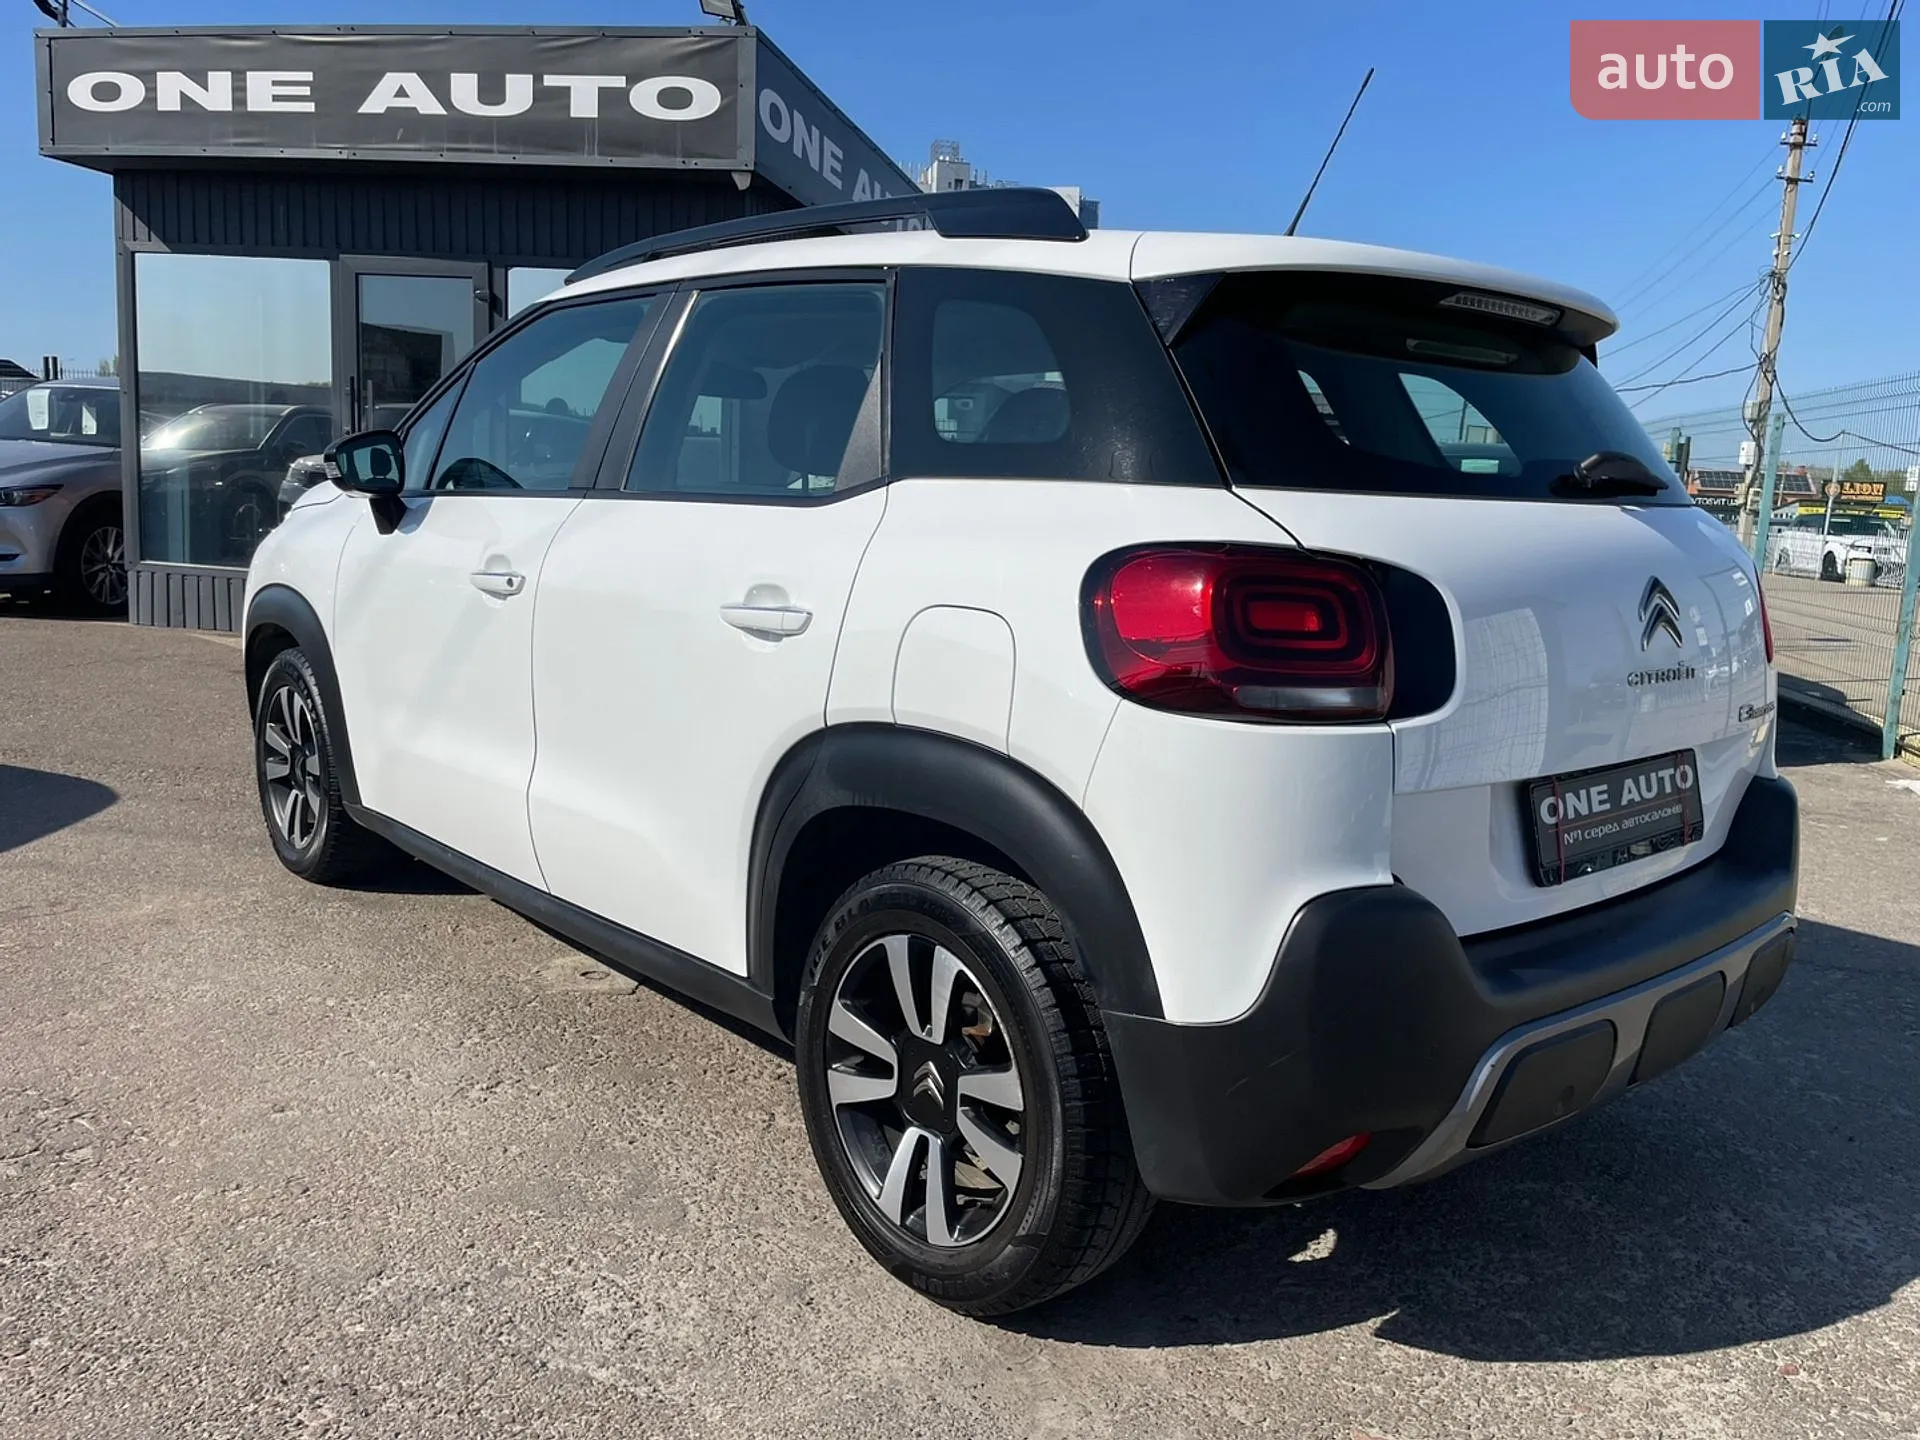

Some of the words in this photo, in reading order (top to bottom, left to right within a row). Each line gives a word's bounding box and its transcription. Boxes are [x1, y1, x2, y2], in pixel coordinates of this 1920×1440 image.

[67, 70, 316, 114] ONE
[357, 72, 722, 121] AUTO
[758, 88, 844, 191] ONE
[1539, 783, 1612, 826] ONE
[1620, 763, 1695, 807] AUTO
